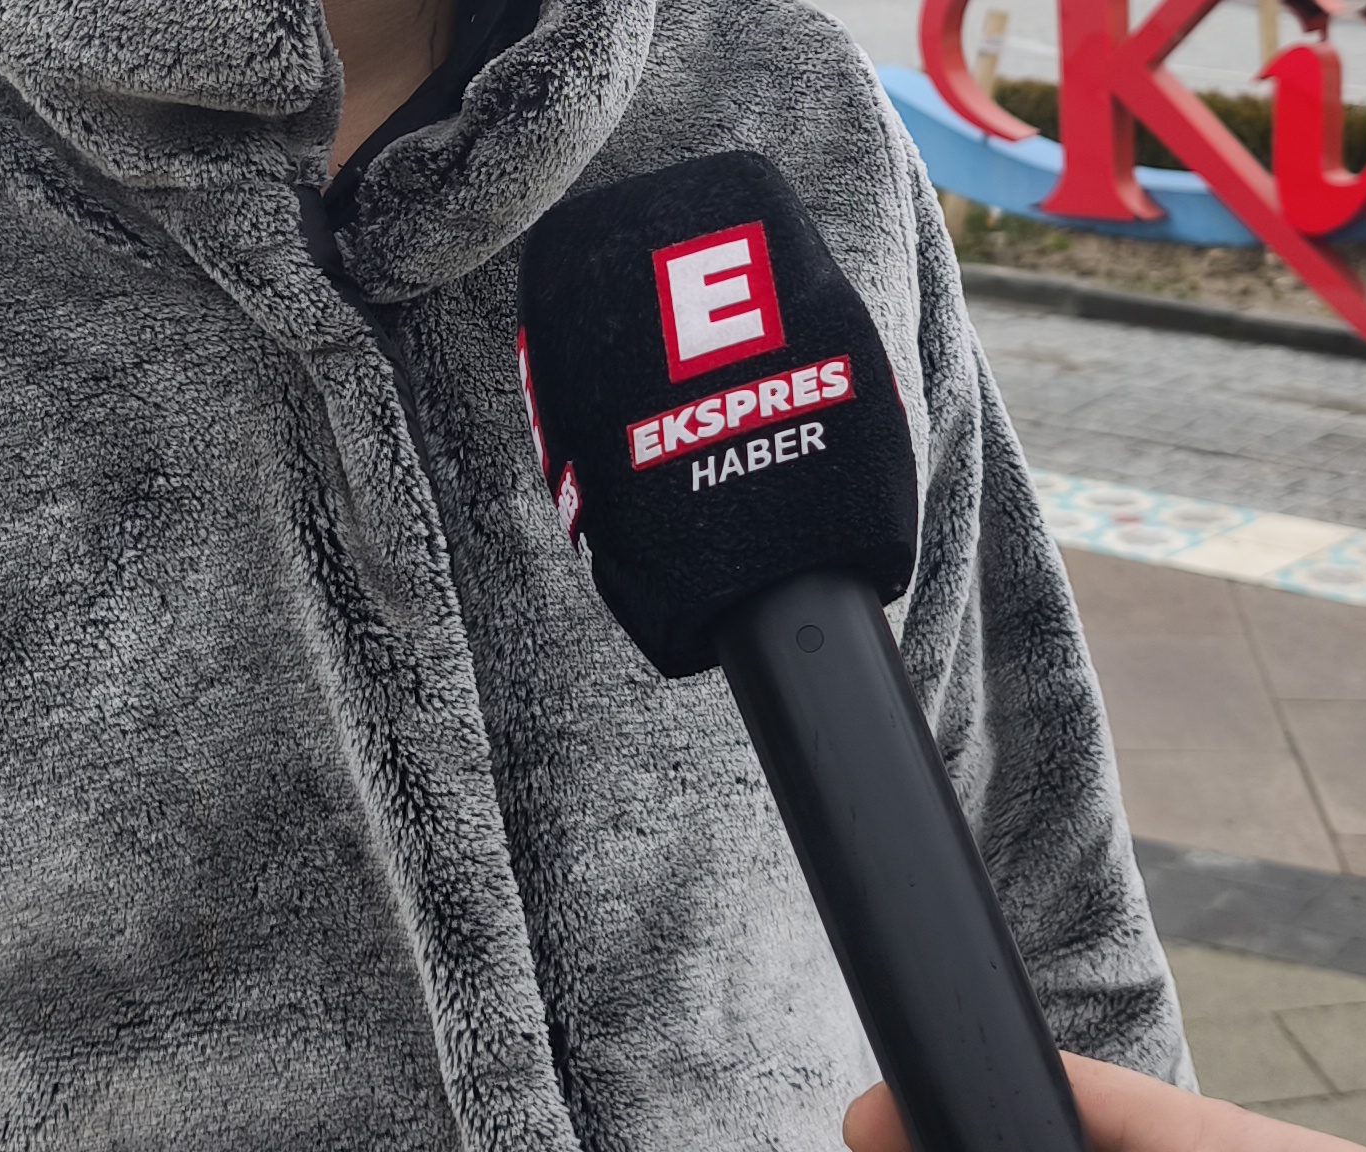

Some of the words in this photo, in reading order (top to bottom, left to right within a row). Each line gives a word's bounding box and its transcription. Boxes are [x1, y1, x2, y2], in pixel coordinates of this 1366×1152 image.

[666, 238, 765, 362] E
[632, 361, 849, 465] EKSPRES
[691, 421, 827, 492] HABER
